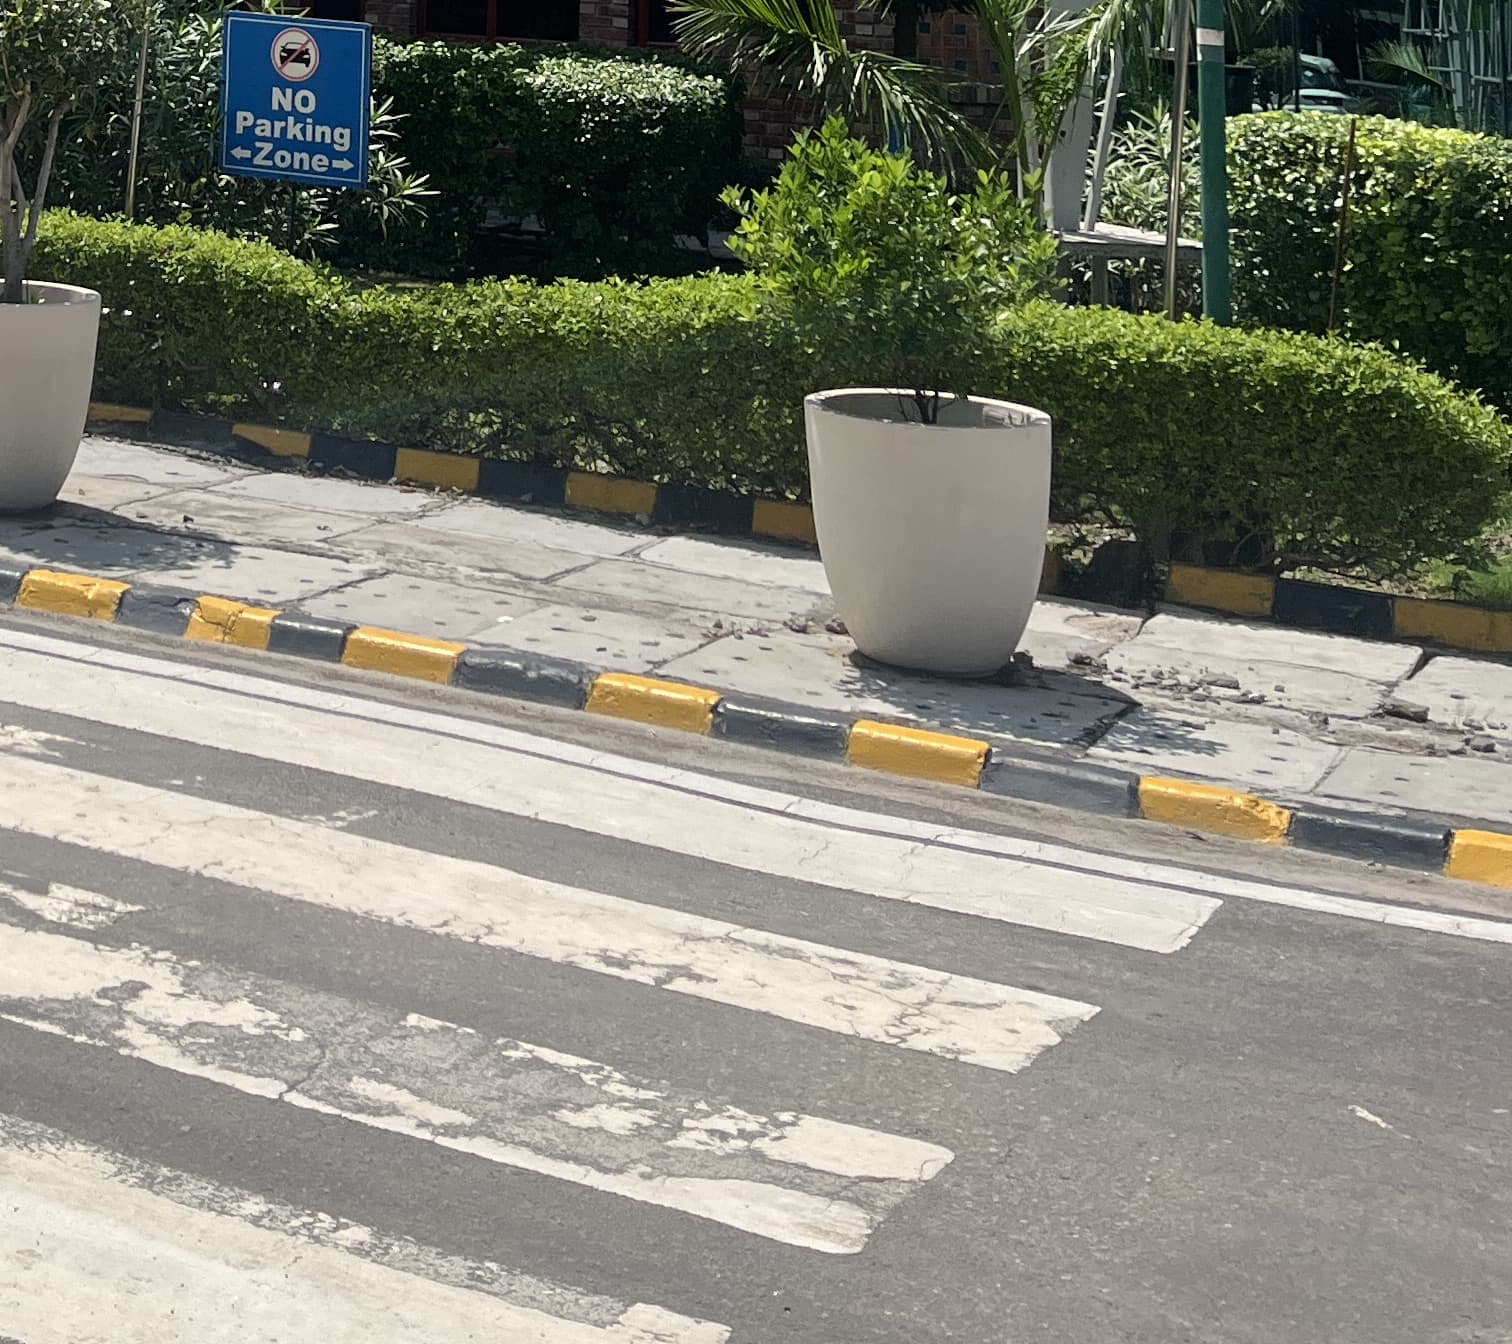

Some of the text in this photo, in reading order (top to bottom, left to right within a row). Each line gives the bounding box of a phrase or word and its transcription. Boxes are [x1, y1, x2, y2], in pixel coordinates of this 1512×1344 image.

[271, 87, 316, 113] NO
[235, 112, 351, 151] Parking
[253, 142, 330, 172] Zone
